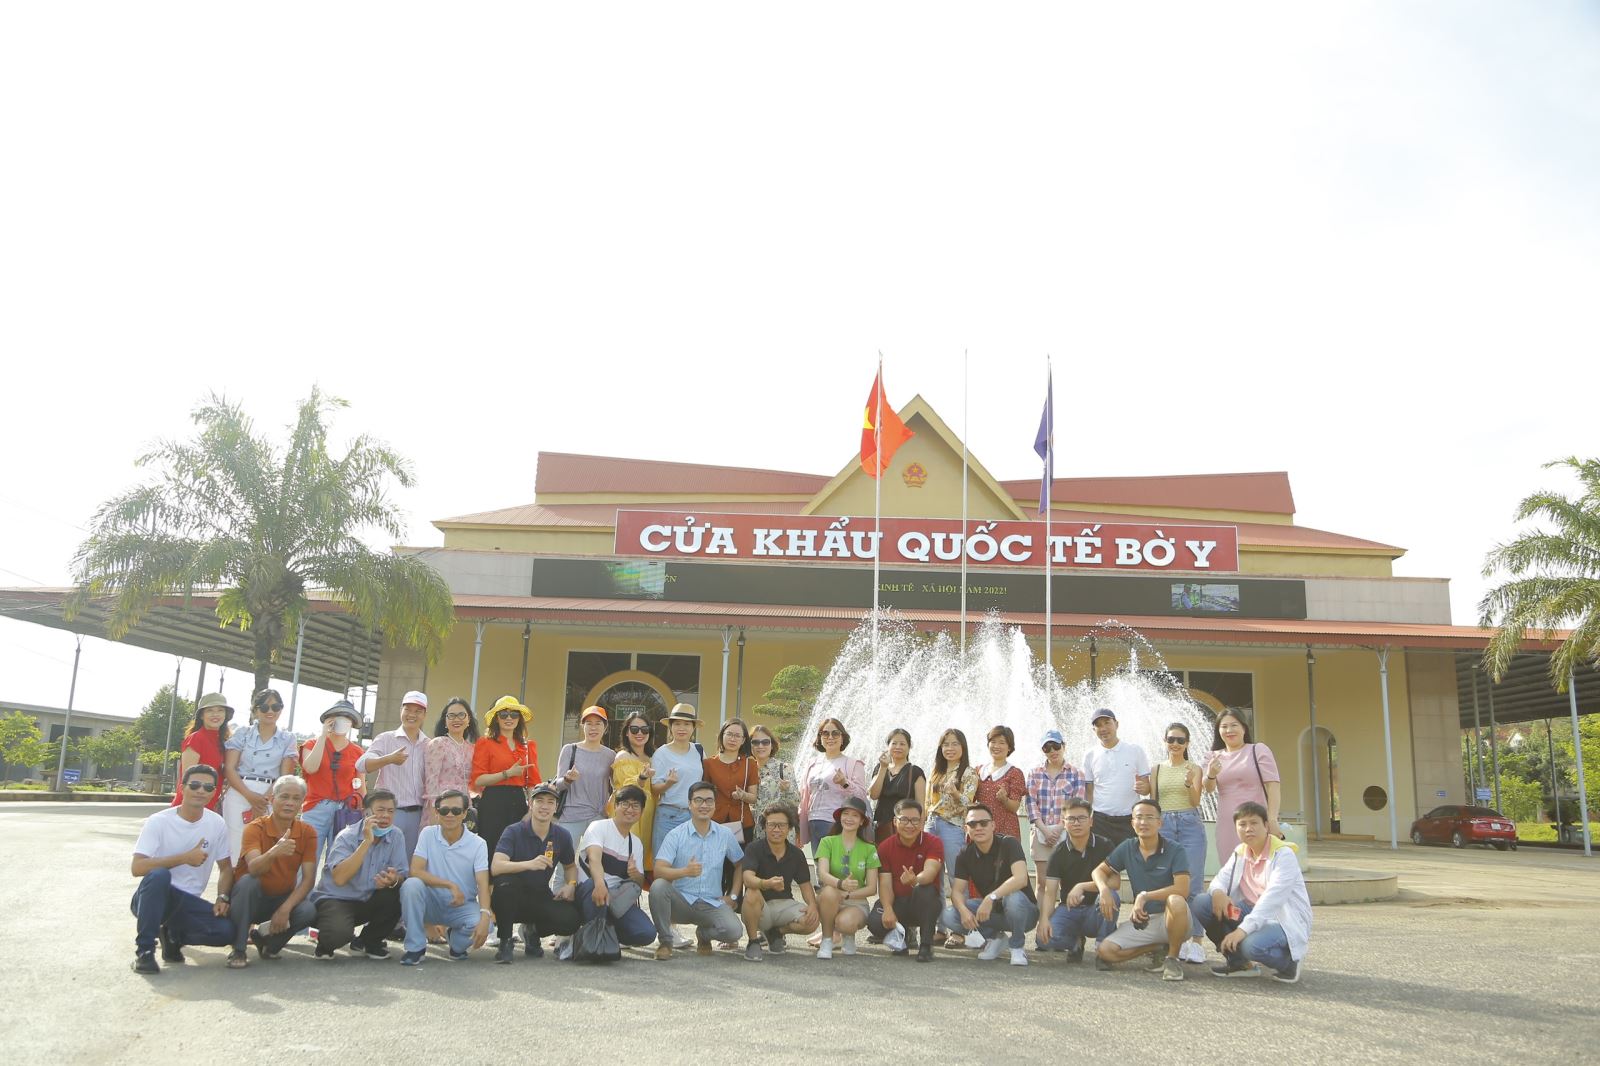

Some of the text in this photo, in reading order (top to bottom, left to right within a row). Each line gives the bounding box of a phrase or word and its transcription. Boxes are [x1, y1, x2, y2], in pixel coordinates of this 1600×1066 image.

[639, 516, 737, 554] CỬA
[752, 517, 883, 558] KHẨU
[897, 522, 1032, 562] QUỐC
[1048, 524, 1102, 564] TẾ
[1185, 540, 1216, 567] Y
